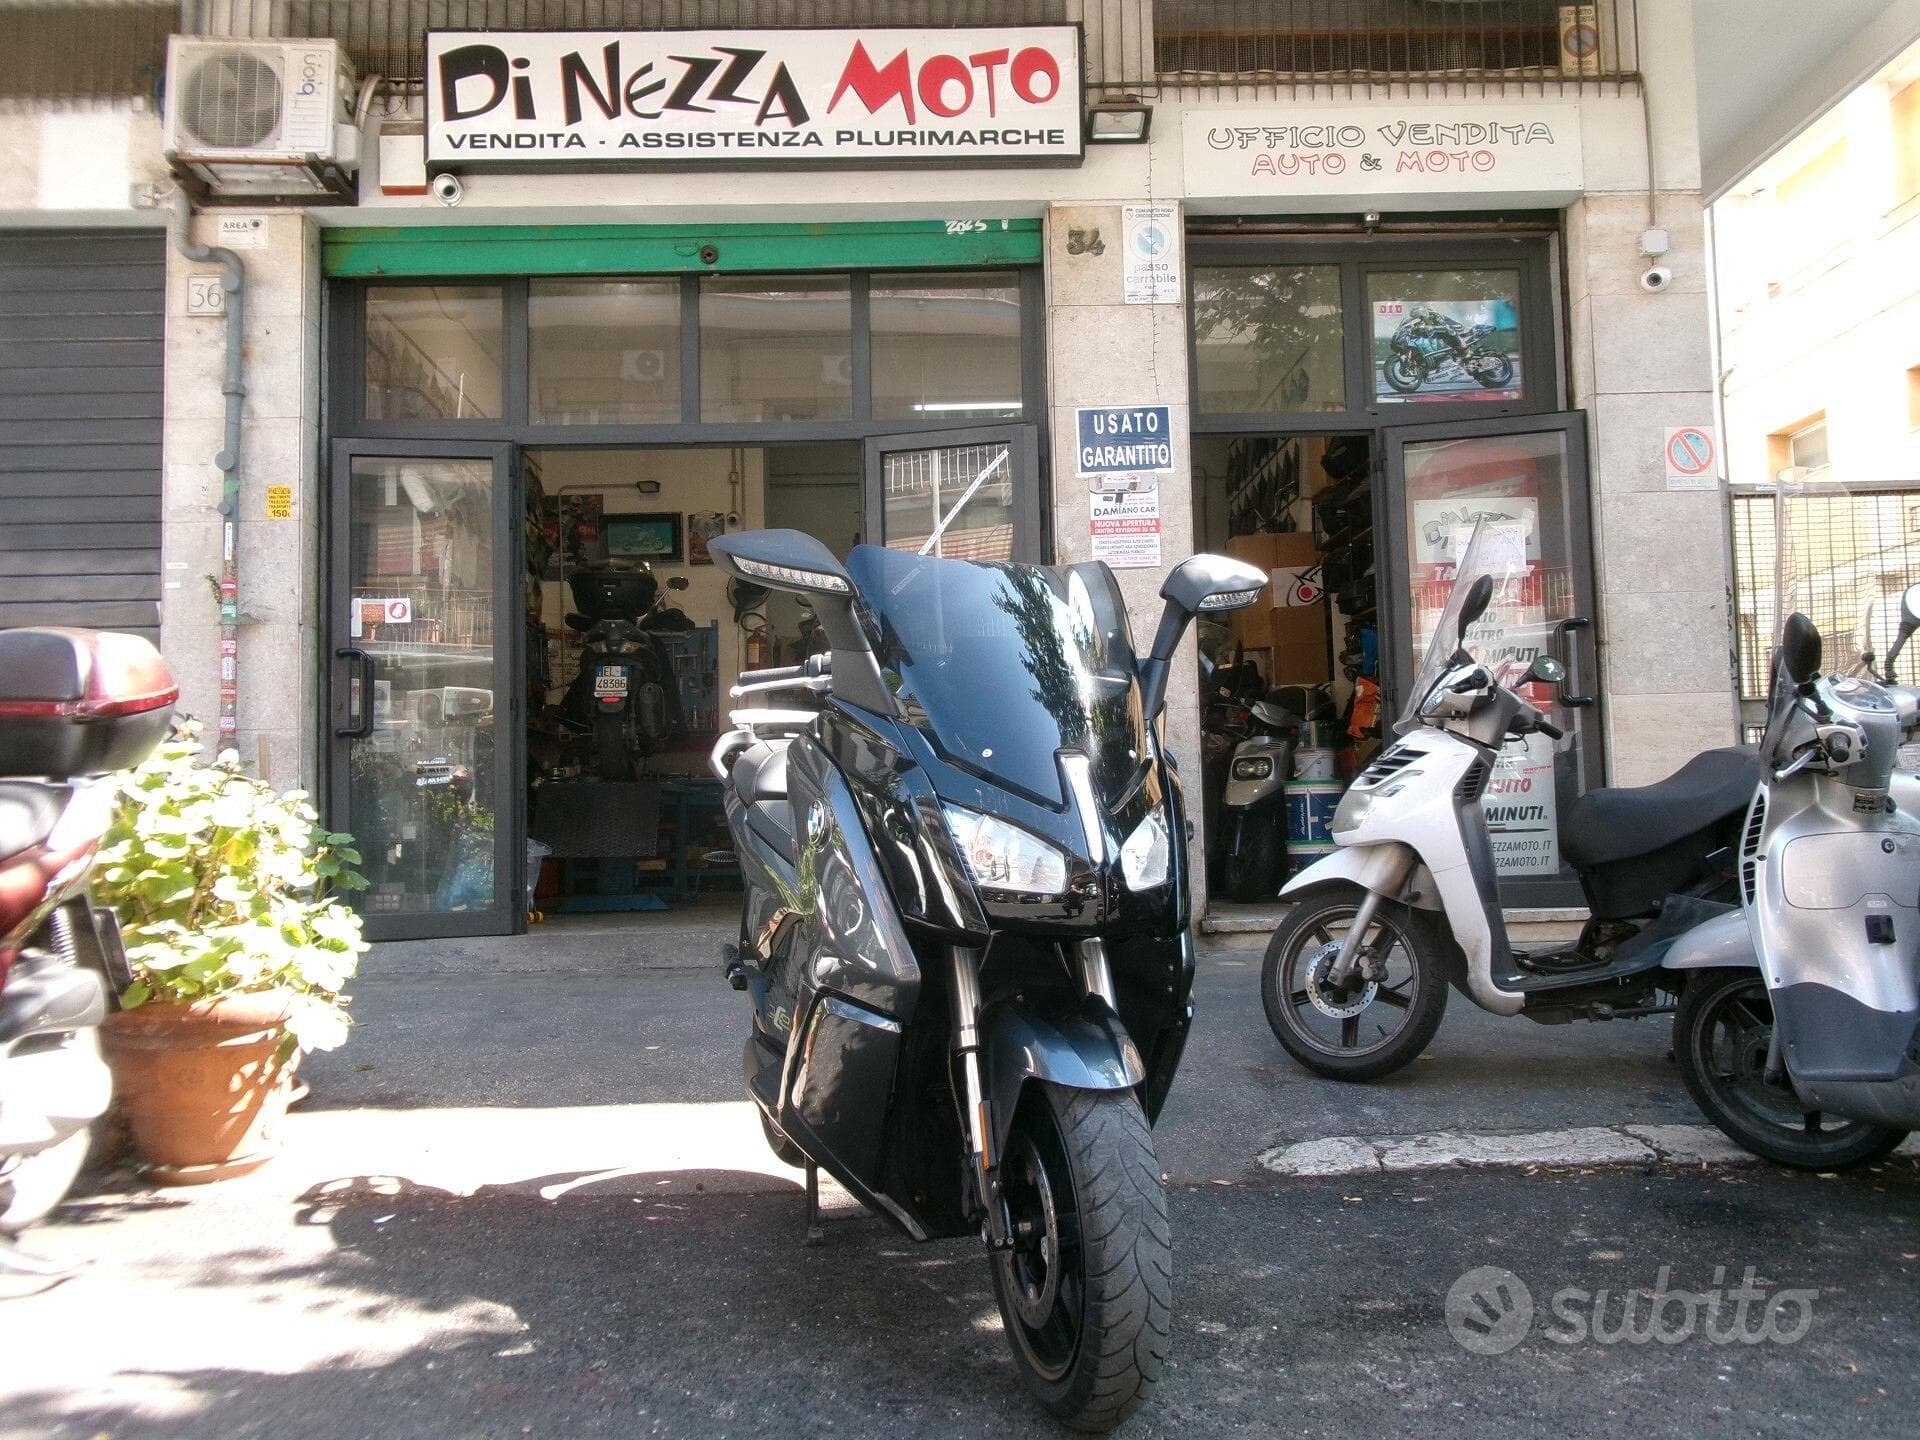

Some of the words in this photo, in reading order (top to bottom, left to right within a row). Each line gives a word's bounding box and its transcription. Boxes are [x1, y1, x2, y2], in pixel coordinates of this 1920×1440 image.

[826, 38, 1061, 126] MOTO
[446, 131, 586, 151] VENDITA
[617, 130, 824, 149] ASSISTENZA
[835, 128, 1066, 147] PLURIMARCHE
[1207, 125, 1366, 151] UFFICIO
[1377, 120, 1554, 148] VENDITA
[1252, 151, 1347, 176] AUTO
[1359, 152, 1383, 172] &
[1396, 149, 1497, 174] MOTO
[1126, 273, 1177, 284] carrabile
[1134, 263, 1169, 274] passo
[191, 283, 221, 308] 36
[1093, 412, 1159, 434] USATO
[1082, 443, 1170, 468] GARANTITO
[1094, 507, 1139, 517] DAMIANO
[1140, 506, 1156, 514] CAR
[1095, 520, 1120, 528] NUOVA
[1122, 519, 1157, 527] APERTURA
[1492, 841, 1552, 853] EZZAMOTO.IT
[1495, 856, 1550, 868] ZZAMOTO.IT
